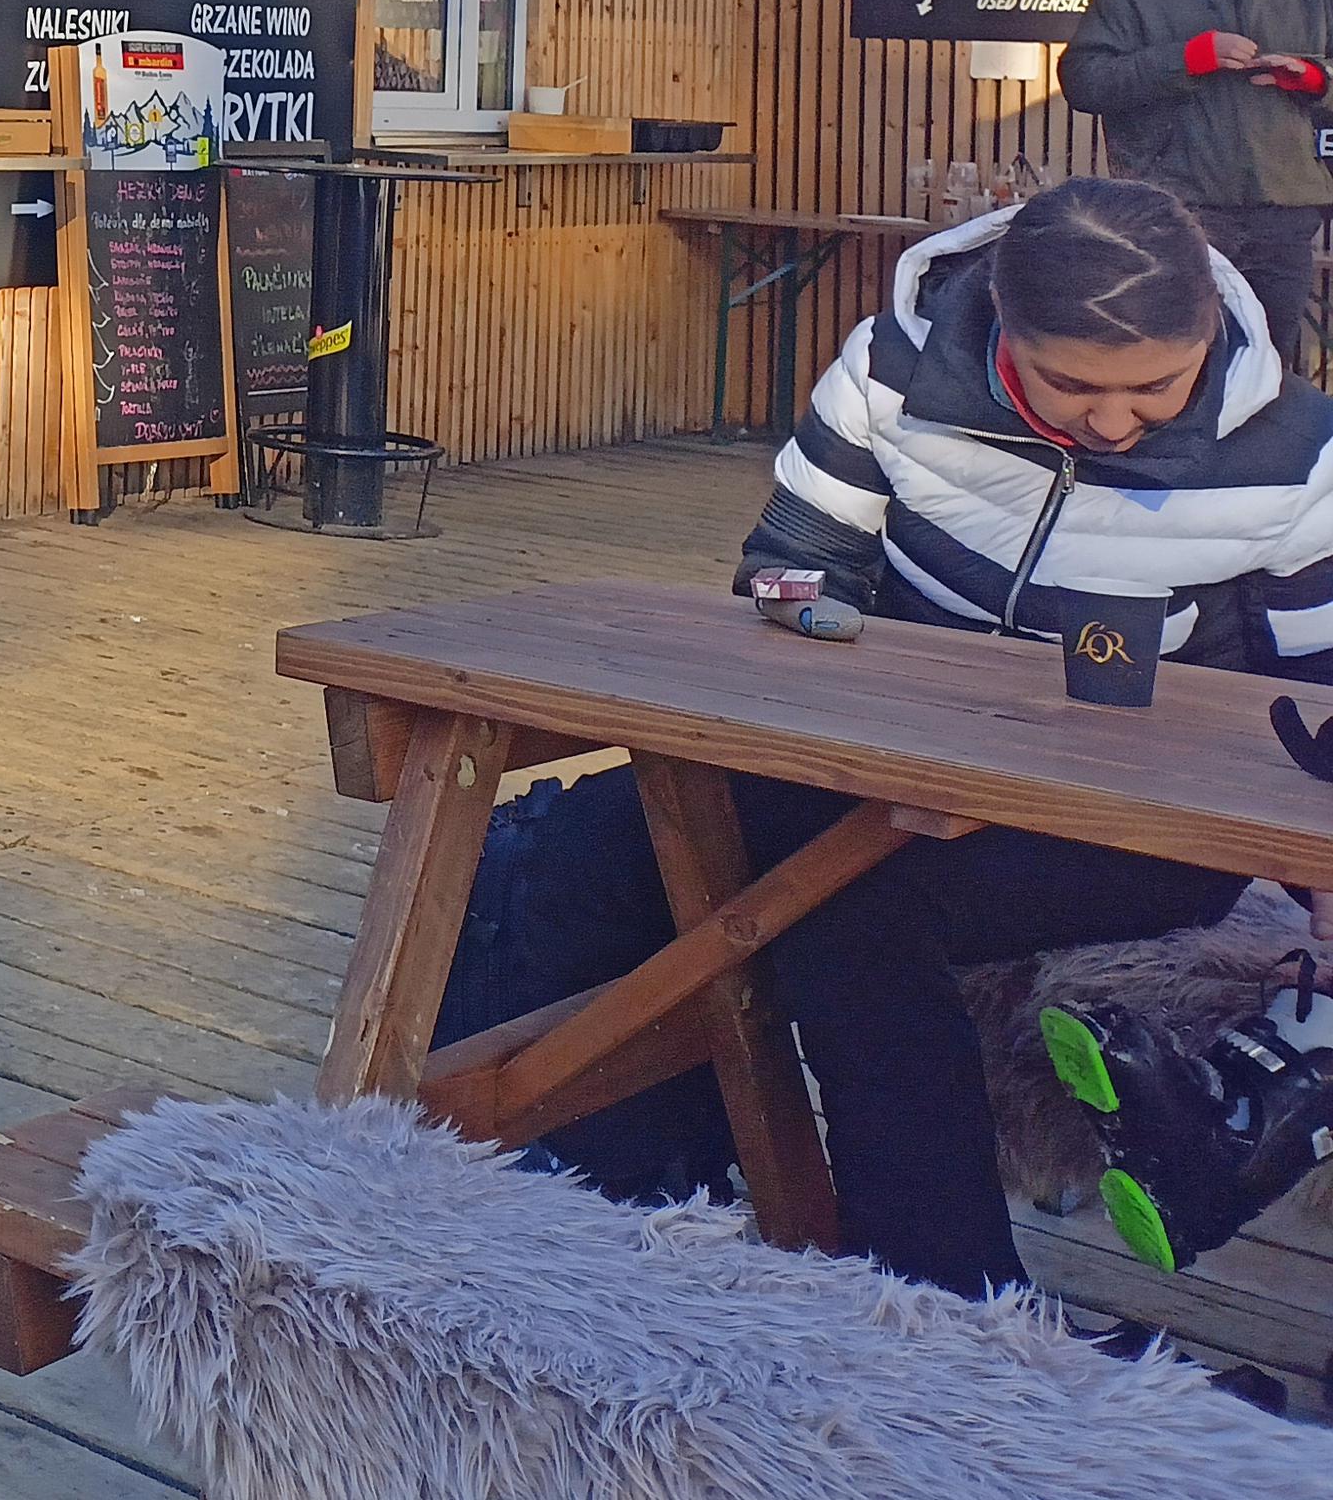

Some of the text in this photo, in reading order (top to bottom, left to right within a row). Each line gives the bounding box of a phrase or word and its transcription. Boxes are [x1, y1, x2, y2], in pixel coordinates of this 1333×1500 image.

[26, 7, 130, 40] NALESNIKI
[191, 3, 311, 37] GRZANE WINO
[223, 91, 314, 142] RYTKI
